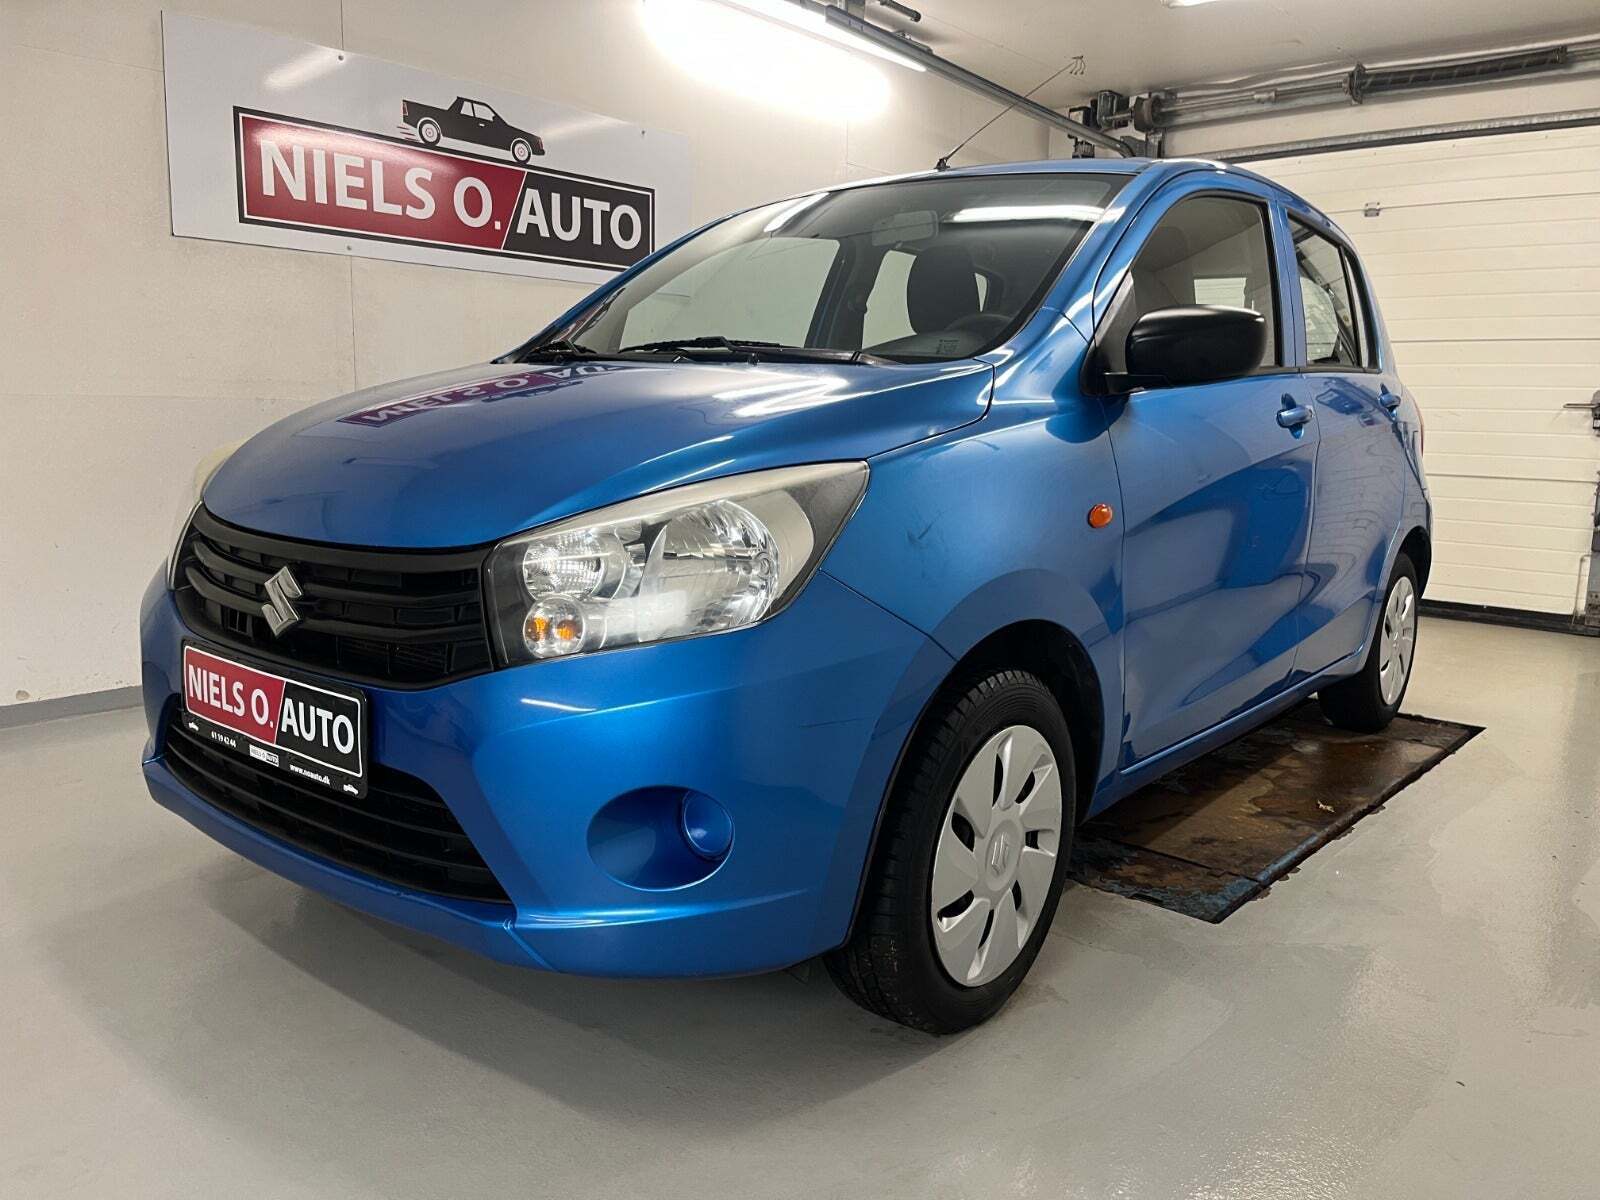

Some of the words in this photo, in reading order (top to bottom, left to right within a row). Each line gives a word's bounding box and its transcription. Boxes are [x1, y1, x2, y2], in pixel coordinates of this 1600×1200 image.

[259, 138, 436, 220] NIELS
[453, 175, 501, 230] O.
[516, 188, 642, 250] AUTO
[188, 663, 245, 717] NIELS
[251, 688, 274, 728] O.
[281, 697, 354, 755] AUTO
